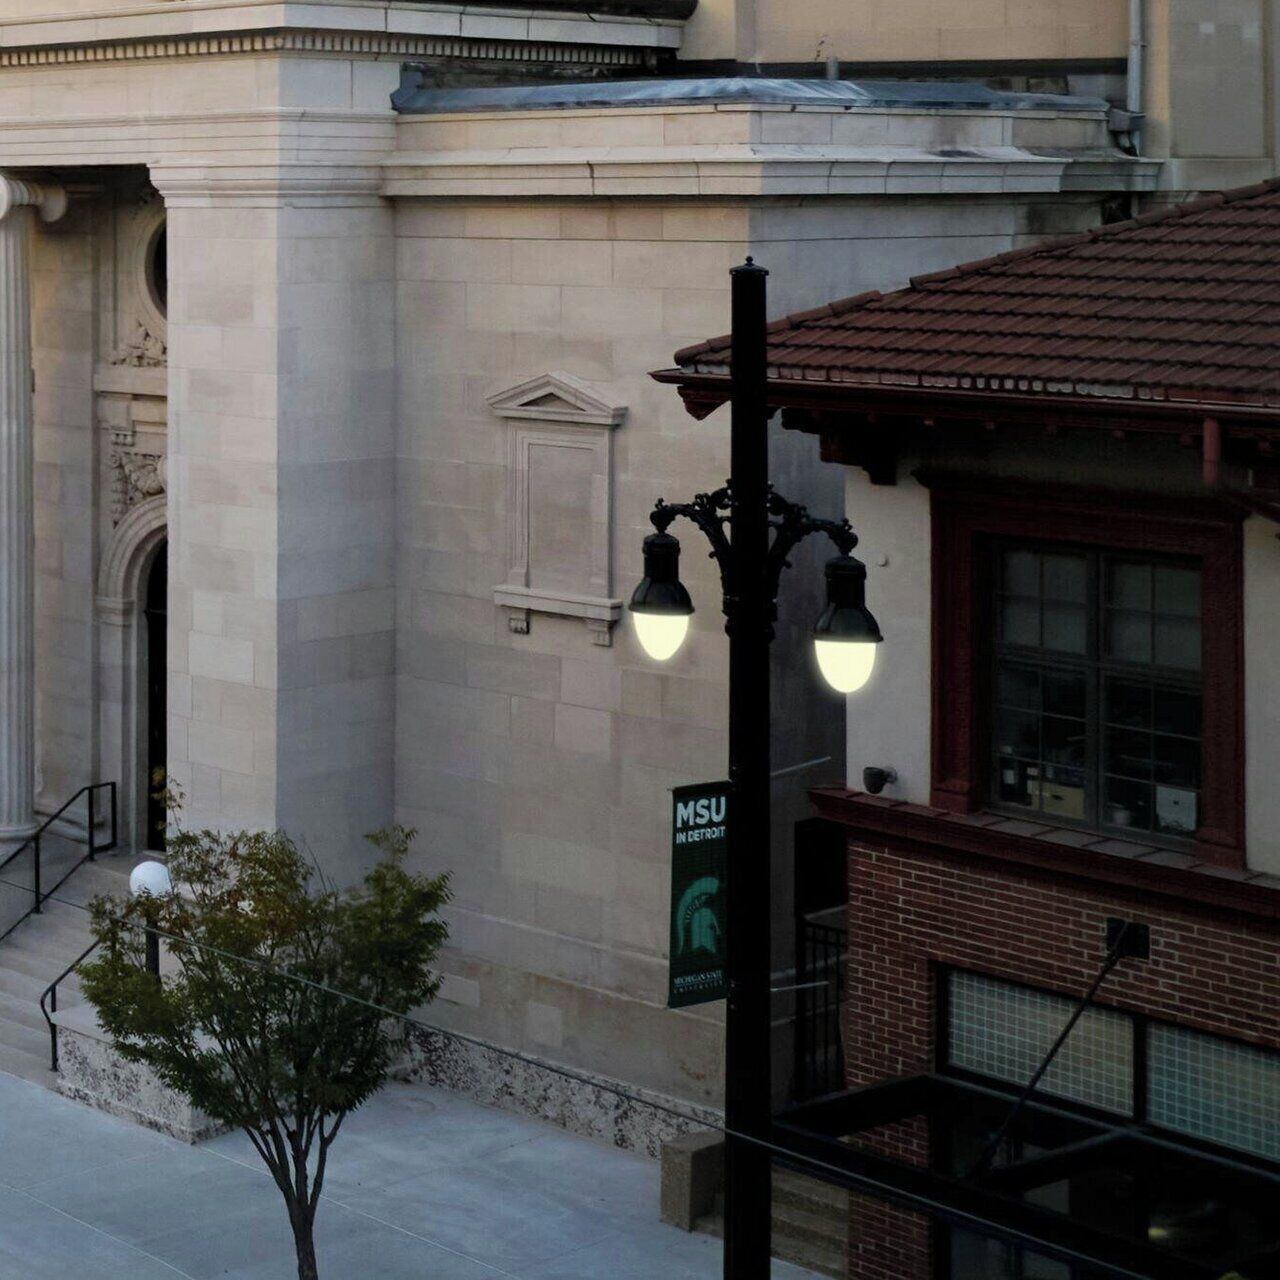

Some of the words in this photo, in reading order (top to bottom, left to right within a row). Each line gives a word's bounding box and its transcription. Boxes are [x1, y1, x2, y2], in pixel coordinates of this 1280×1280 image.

[676, 796, 726, 828] MSU
[676, 832, 686, 844] IN
[687, 826, 726, 842] DETROIT
